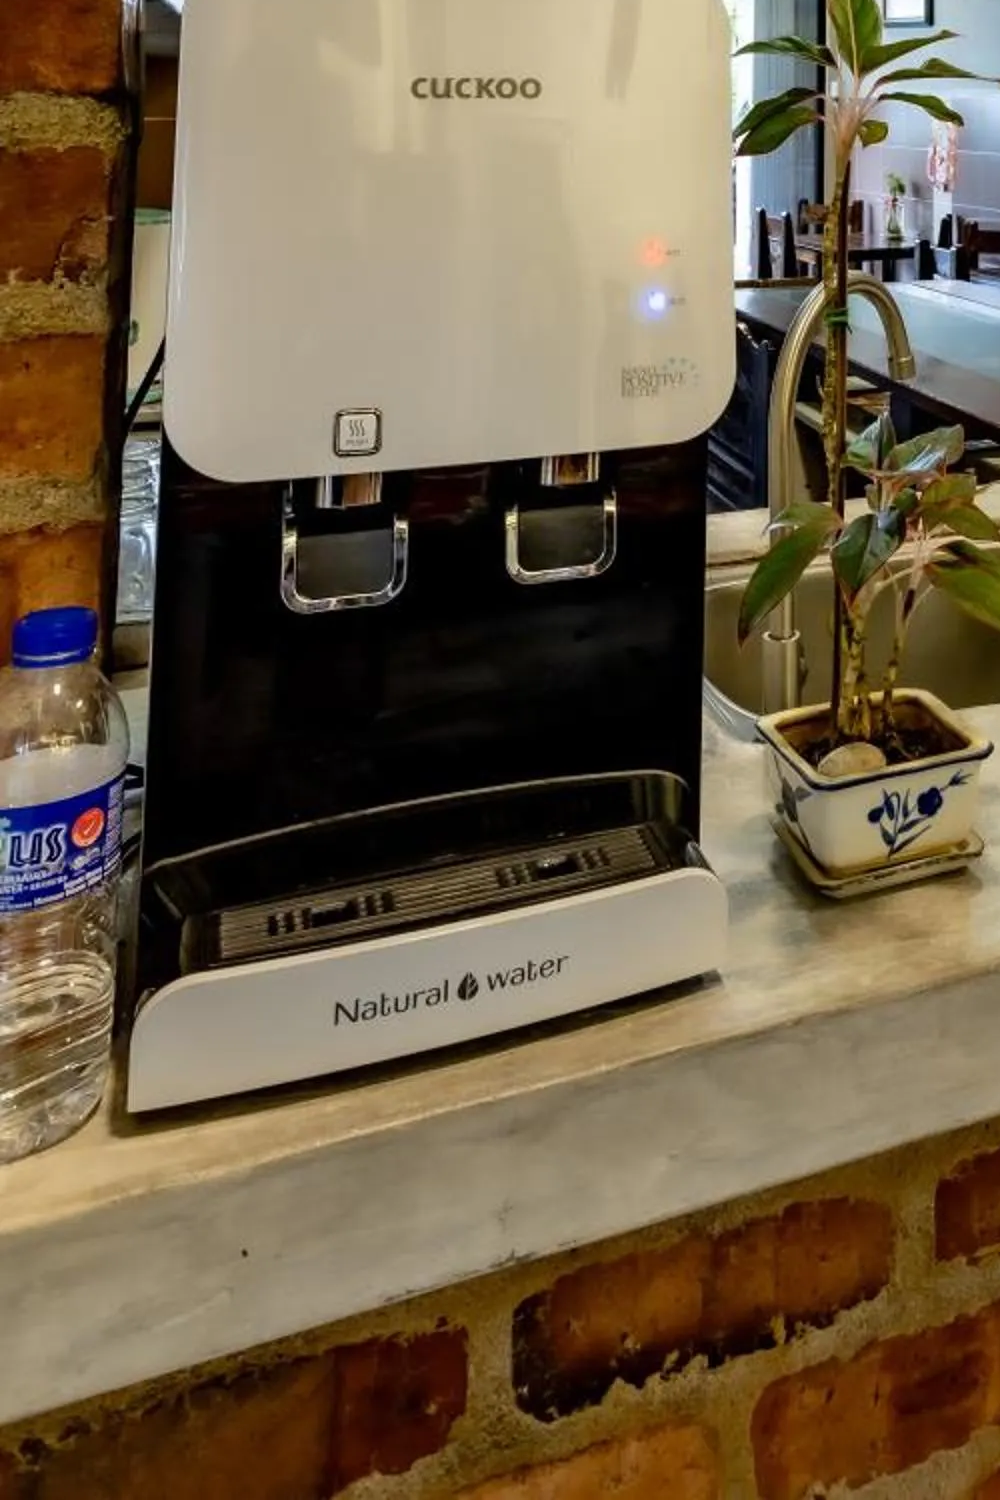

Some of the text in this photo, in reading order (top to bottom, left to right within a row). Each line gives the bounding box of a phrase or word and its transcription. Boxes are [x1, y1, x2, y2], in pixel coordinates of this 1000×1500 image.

[410, 77, 543, 99] CUCKOO
[333, 955, 570, 1026] Natural water
